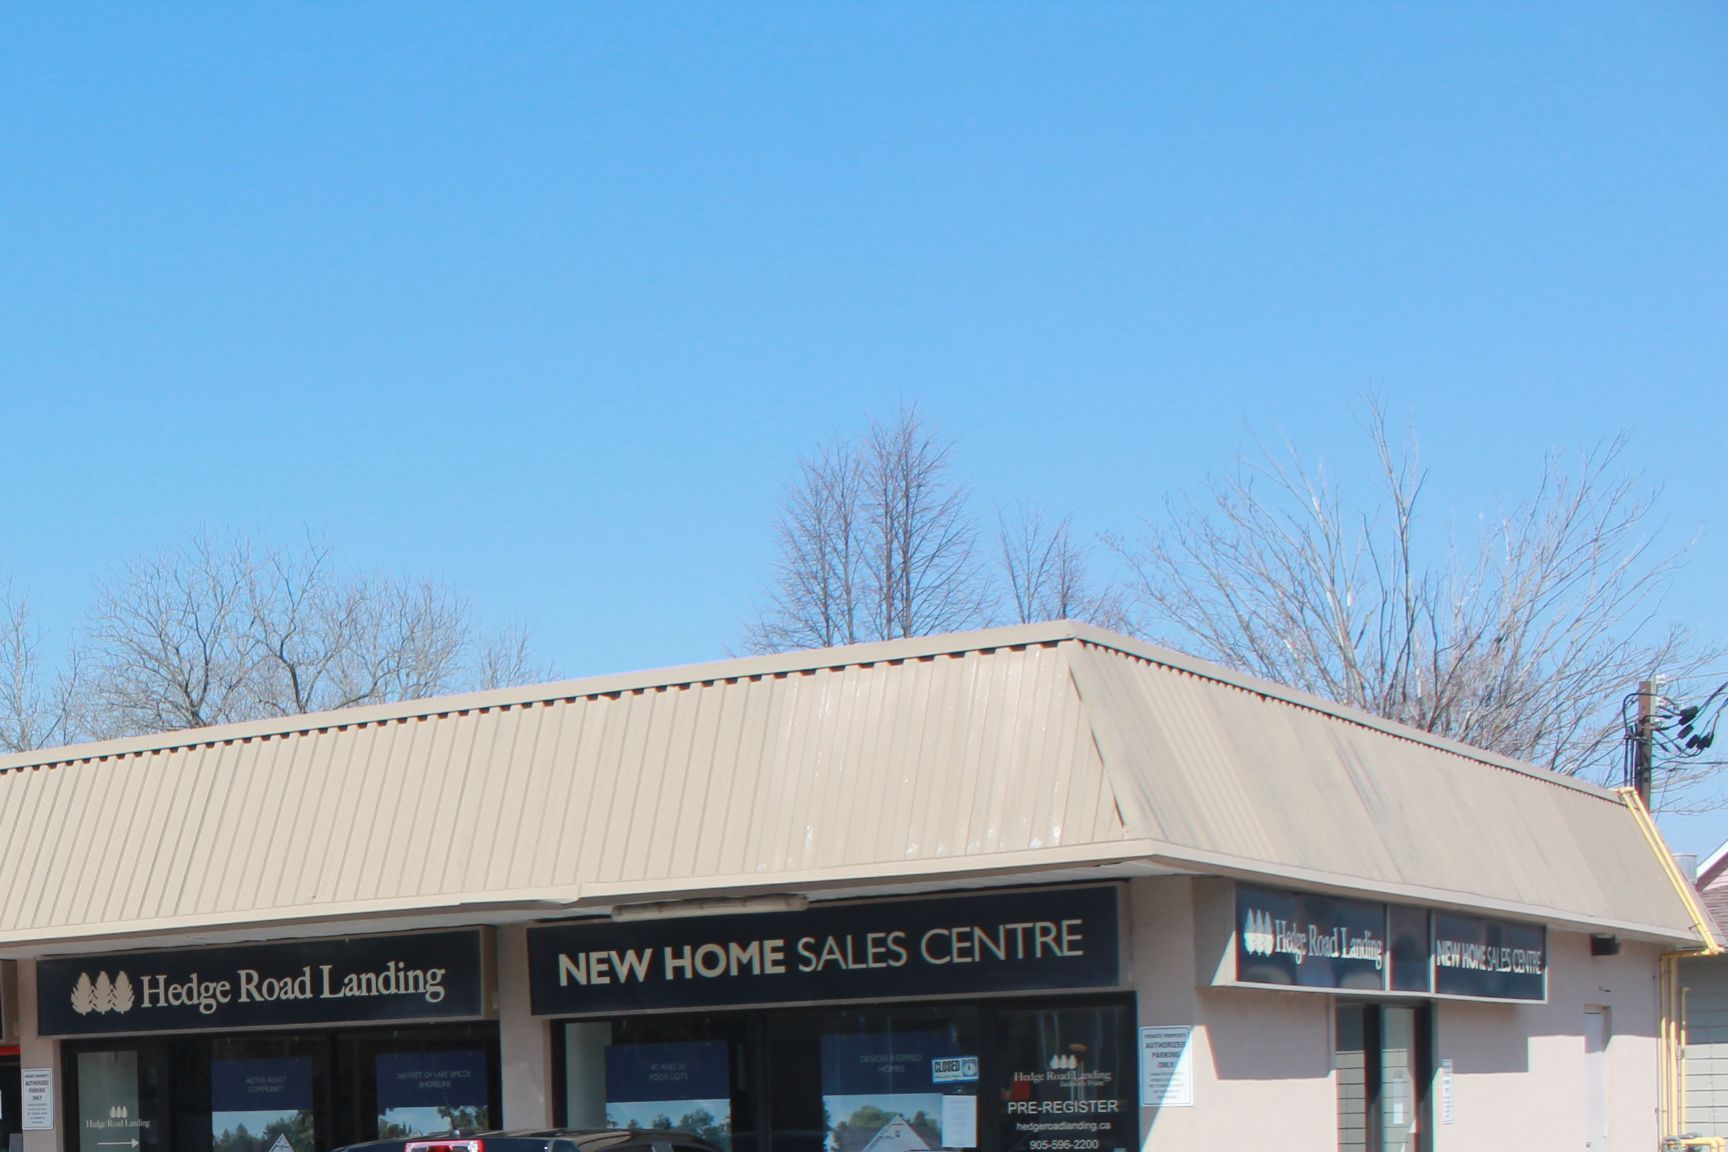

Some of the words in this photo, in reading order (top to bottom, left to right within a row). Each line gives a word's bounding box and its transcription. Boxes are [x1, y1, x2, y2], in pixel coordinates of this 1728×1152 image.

[1274, 919, 1307, 965] Hedge
[1308, 924, 1340, 958] Road
[1340, 927, 1383, 970] Landing
[558, 947, 653, 987] NEW
[664, 939, 786, 980] HOME
[796, 931, 907, 972] SALES
[919, 919, 1084, 964] CENTRE
[1436, 939, 1461, 968] NEW
[1461, 943, 1487, 971] HOME
[1487, 946, 1512, 973] SALES
[1512, 949, 1543, 975] CENTRE
[140, 973, 232, 1014] Hedge
[237, 966, 313, 1002] Road
[319, 960, 446, 1002] Landing
[1145, 1041, 1186, 1049] AUTHORIZED
[934, 1060, 960, 1073] CLOSED
[1014, 1072, 1044, 1084] Hedge
[1046, 1071, 1073, 1081] Road
[1073, 1070, 1112, 1081] Landing
[1007, 1100, 1120, 1114] PRE-REGISTER
[1016, 1121, 1111, 1133] hedgeroadlanding.ca
[1029, 1139, 1100, 1150] 905-596-2200
